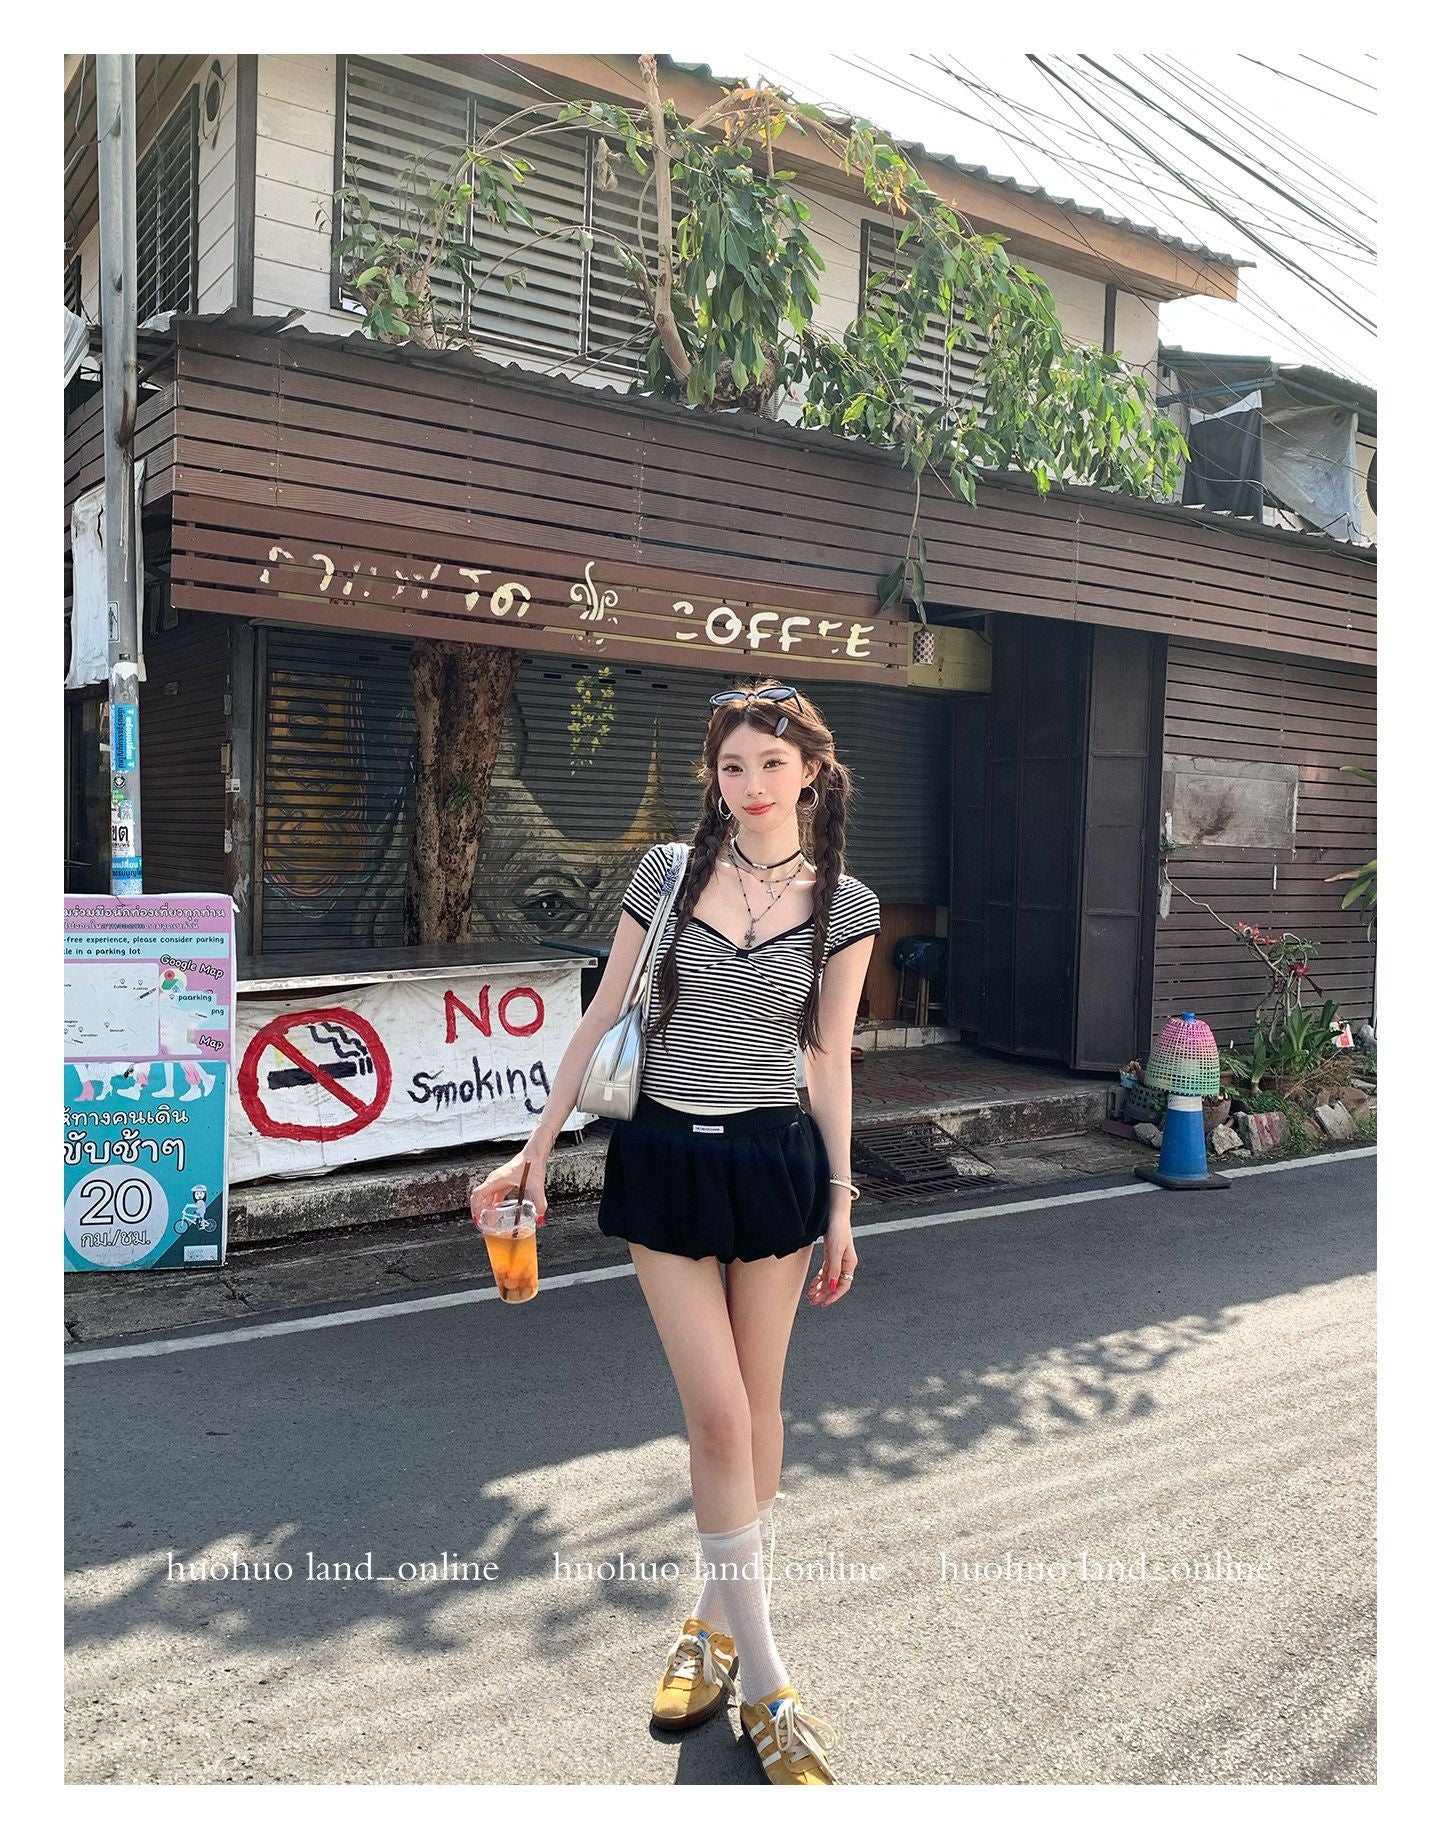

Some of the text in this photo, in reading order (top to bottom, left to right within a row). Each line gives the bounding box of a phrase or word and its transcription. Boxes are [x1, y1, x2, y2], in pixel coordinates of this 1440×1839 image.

[86, 936, 130, 945] experience,
[133, 936, 157, 944] please
[196, 936, 225, 944] parking
[96, 948, 126, 956] parking
[160, 954, 224, 980] Google Map
[443, 984, 546, 1044] NO
[199, 1035, 224, 1051] Map
[407, 1056, 551, 1115] Smoking
[79, 1178, 153, 1226] 20
[80, 1229, 152, 1248] กม./ชม.
